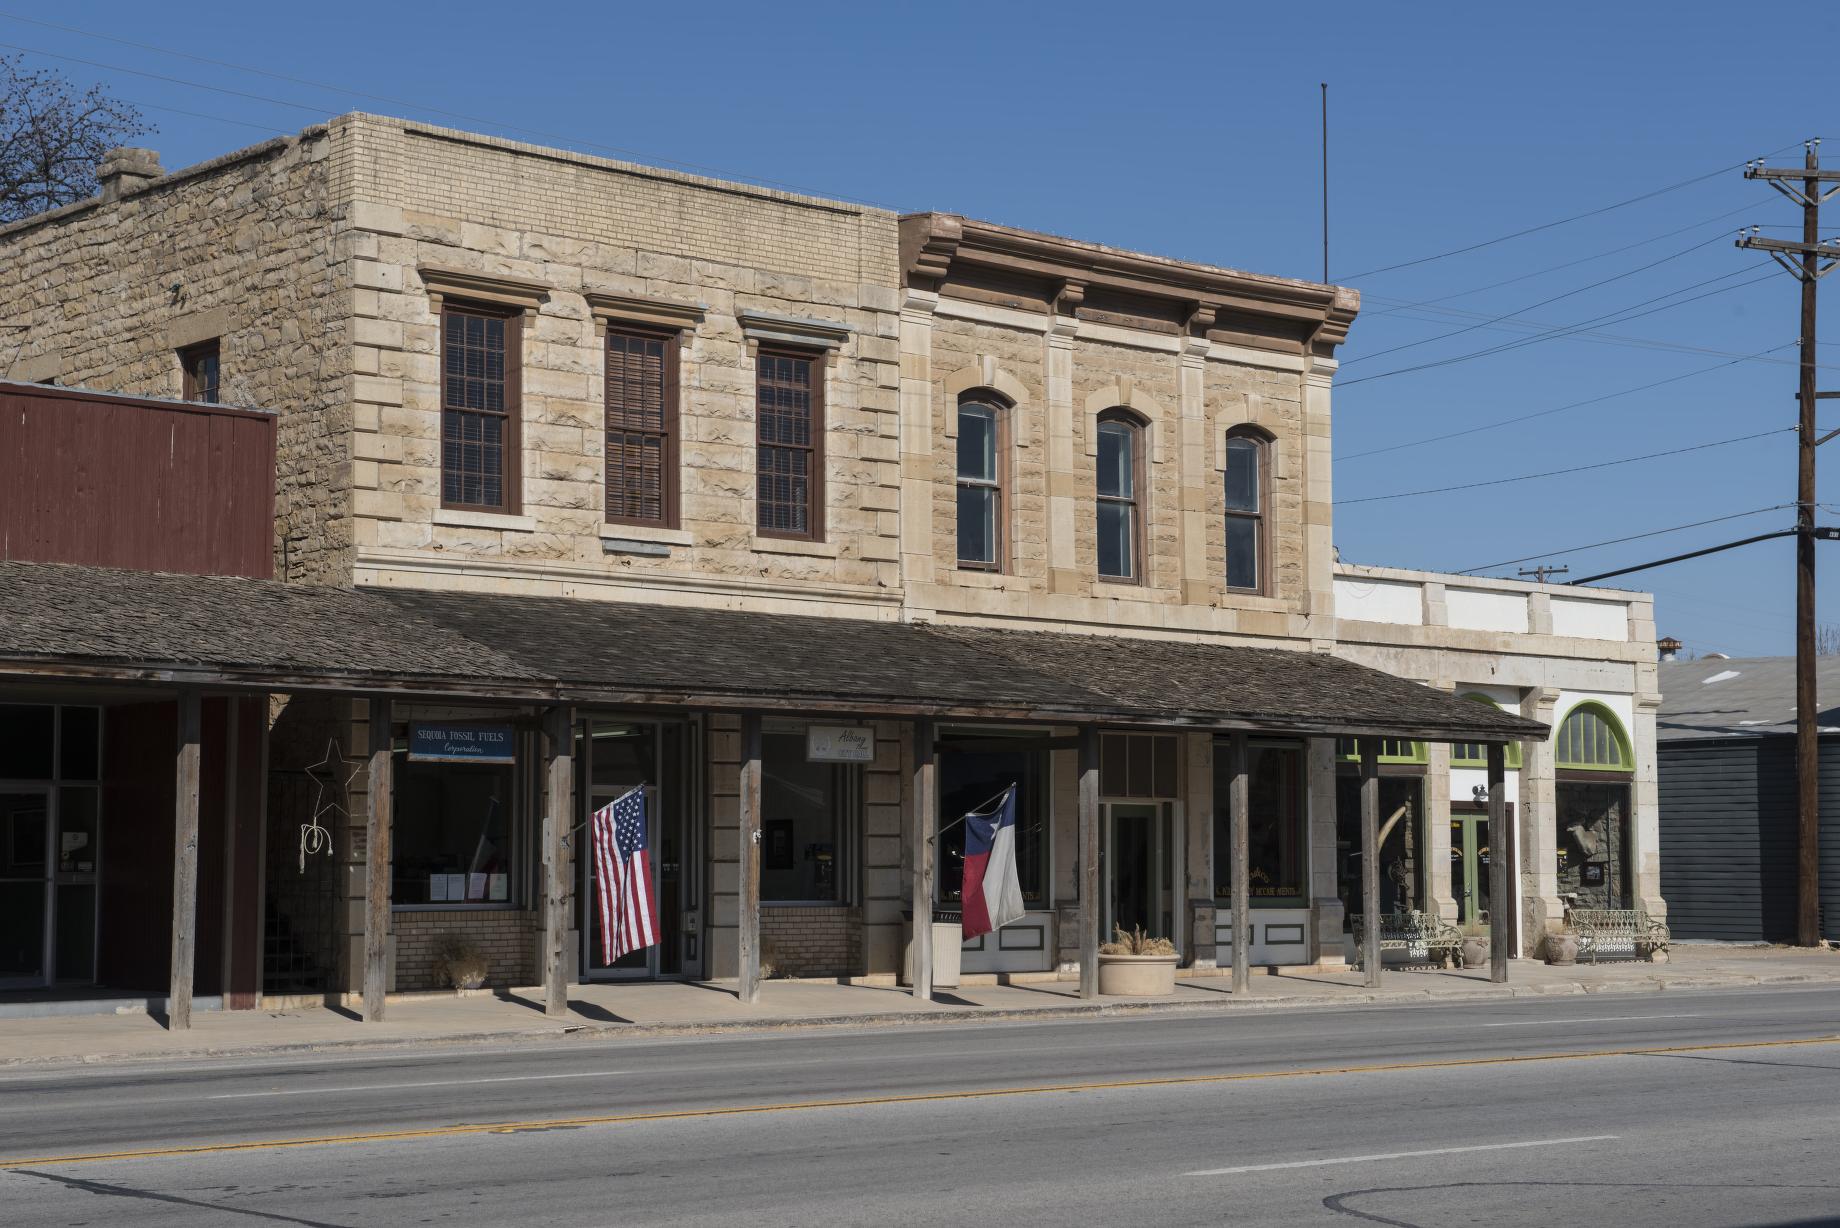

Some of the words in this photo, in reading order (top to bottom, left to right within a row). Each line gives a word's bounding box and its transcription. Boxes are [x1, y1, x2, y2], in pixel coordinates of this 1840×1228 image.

[417, 730, 446, 741] SEQUOIA
[479, 732, 504, 742] FUELS
[444, 742, 484, 755] Corporation
